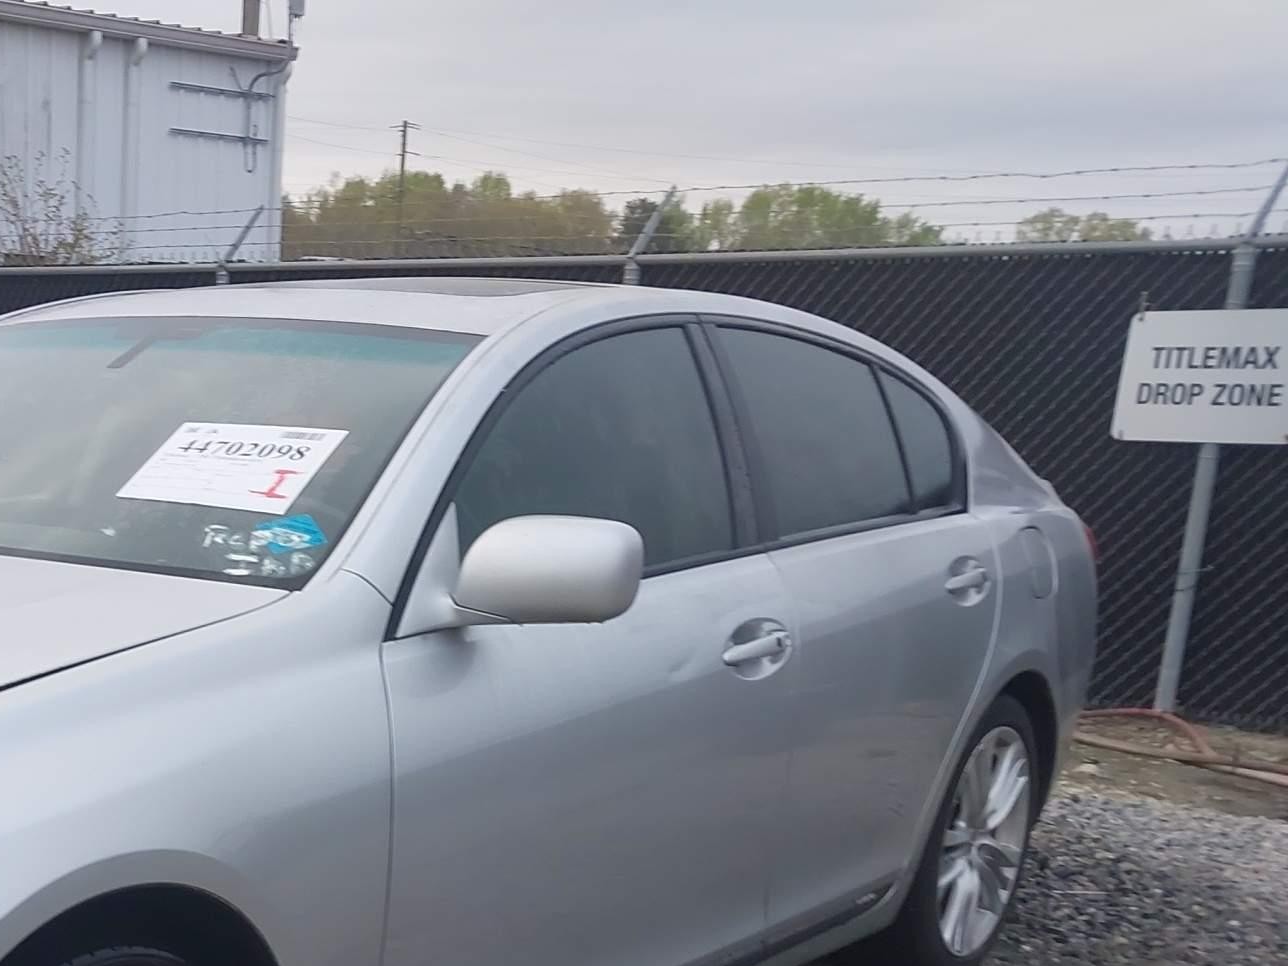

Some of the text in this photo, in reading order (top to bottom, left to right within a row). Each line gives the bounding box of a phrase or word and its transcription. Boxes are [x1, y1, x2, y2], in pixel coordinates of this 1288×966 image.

[1152, 345, 1281, 370] TITLEMAX
[1136, 382, 1285, 407] DROP ZONE
[177, 438, 312, 461] 44702098
